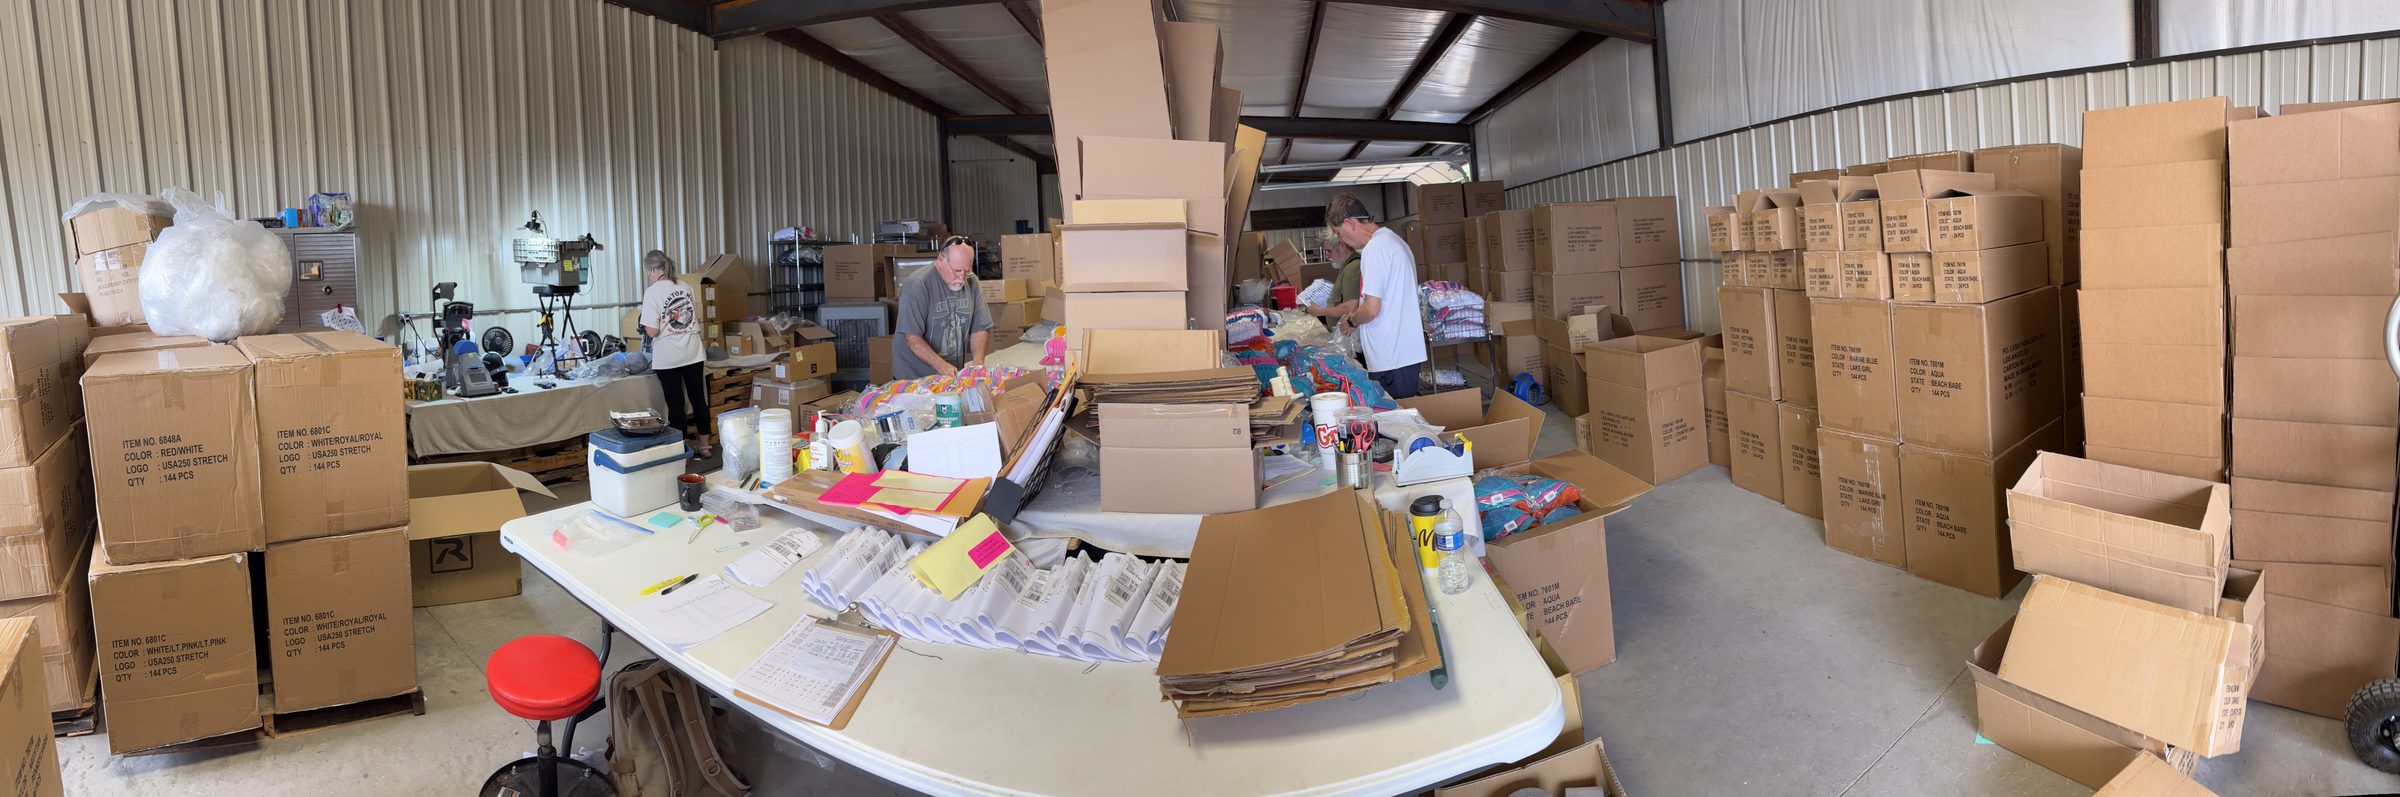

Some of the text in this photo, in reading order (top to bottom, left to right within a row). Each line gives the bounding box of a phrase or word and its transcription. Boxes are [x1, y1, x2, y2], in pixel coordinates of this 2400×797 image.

[1931, 370, 1944, 378] AQUA
[1931, 380, 1947, 388] BEACH
[277, 426, 331, 439] ITEM NO. 6801C
[123, 435, 182, 448] ITEM NO. 6848A
[279, 432, 383, 450] COLOR WHITE/ROYAL/ROYAL
[125, 444, 203, 461] COLOR RED/WHITE
[280, 445, 371, 462] LOGO USA250 STRETCH
[126, 455, 228, 474] LOGO USA250 STRETCH
[280, 466, 296, 474] Q'TY
[327, 461, 340, 469] PCS
[128, 471, 194, 487] Q'TY 144 PCS
[1915, 499, 1925, 507] ITEM
[1936, 504, 1949, 512] 7601M
[1916, 508, 1950, 521] COLOR AQUA
[1916, 517, 1967, 533] STATE BEACH BABE
[1517, 593, 1527, 601] EM
[1541, 582, 1559, 594] 7601M
[1543, 593, 1560, 604] AQUA
[1544, 603, 1565, 615] BEACH
[283, 611, 335, 625] ITEM NO. 6801C
[284, 613, 387, 636] COLOR WHITE/ROYAL/ROYAL
[1556, 612, 1568, 622] PCS
[112, 640, 129, 648] ITEM
[145, 635, 166, 644] 6801C
[285, 626, 375, 646] LOGO USA250 STRETCH
[114, 637, 226, 659] COLOR WHITE/LT.PINK/LT.PINK
[287, 649, 301, 657] Q'TY
[332, 641, 345, 650] PCS
[115, 651, 208, 671] LOGO USA250 STRETCH
[116, 674, 132, 682] Q'TY
[163, 667, 177, 676] PCS
